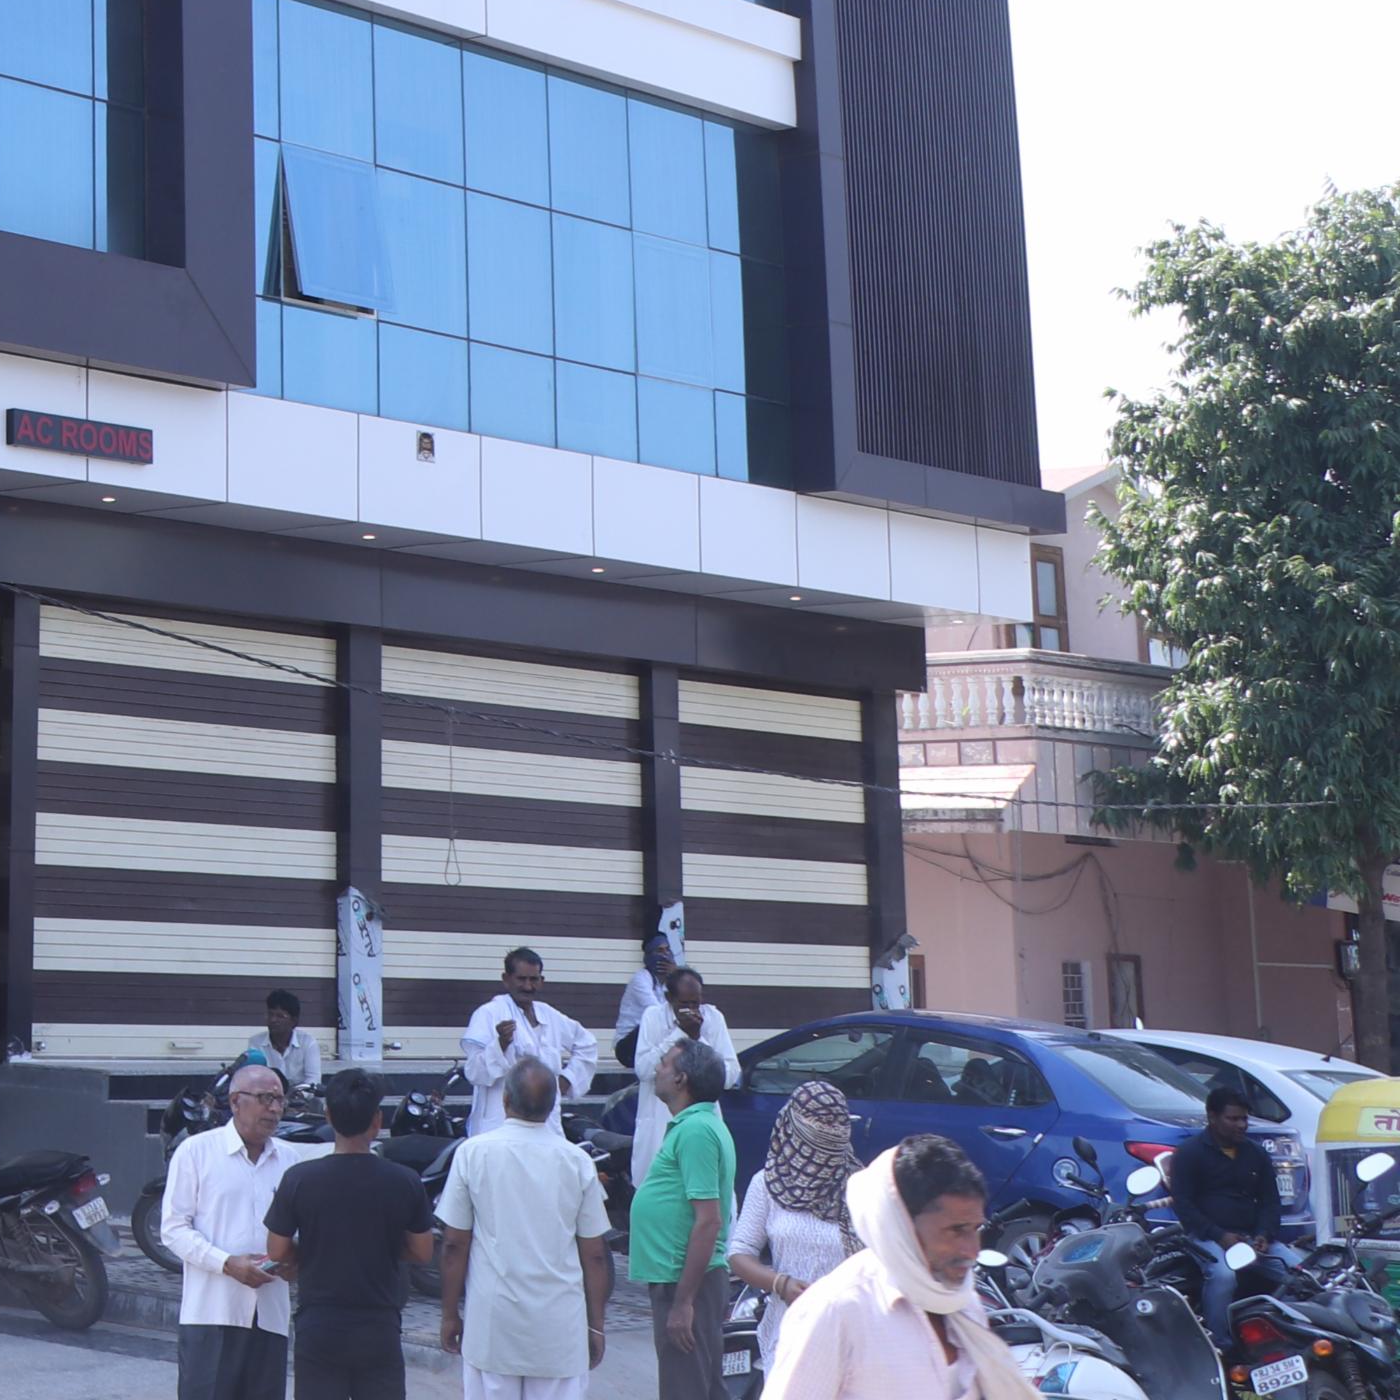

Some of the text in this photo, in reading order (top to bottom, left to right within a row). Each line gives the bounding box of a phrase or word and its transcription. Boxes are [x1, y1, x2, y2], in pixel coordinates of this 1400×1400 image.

[16, 412, 153, 460] AC ROOMS
[1258, 1370, 1304, 1393] 8920
